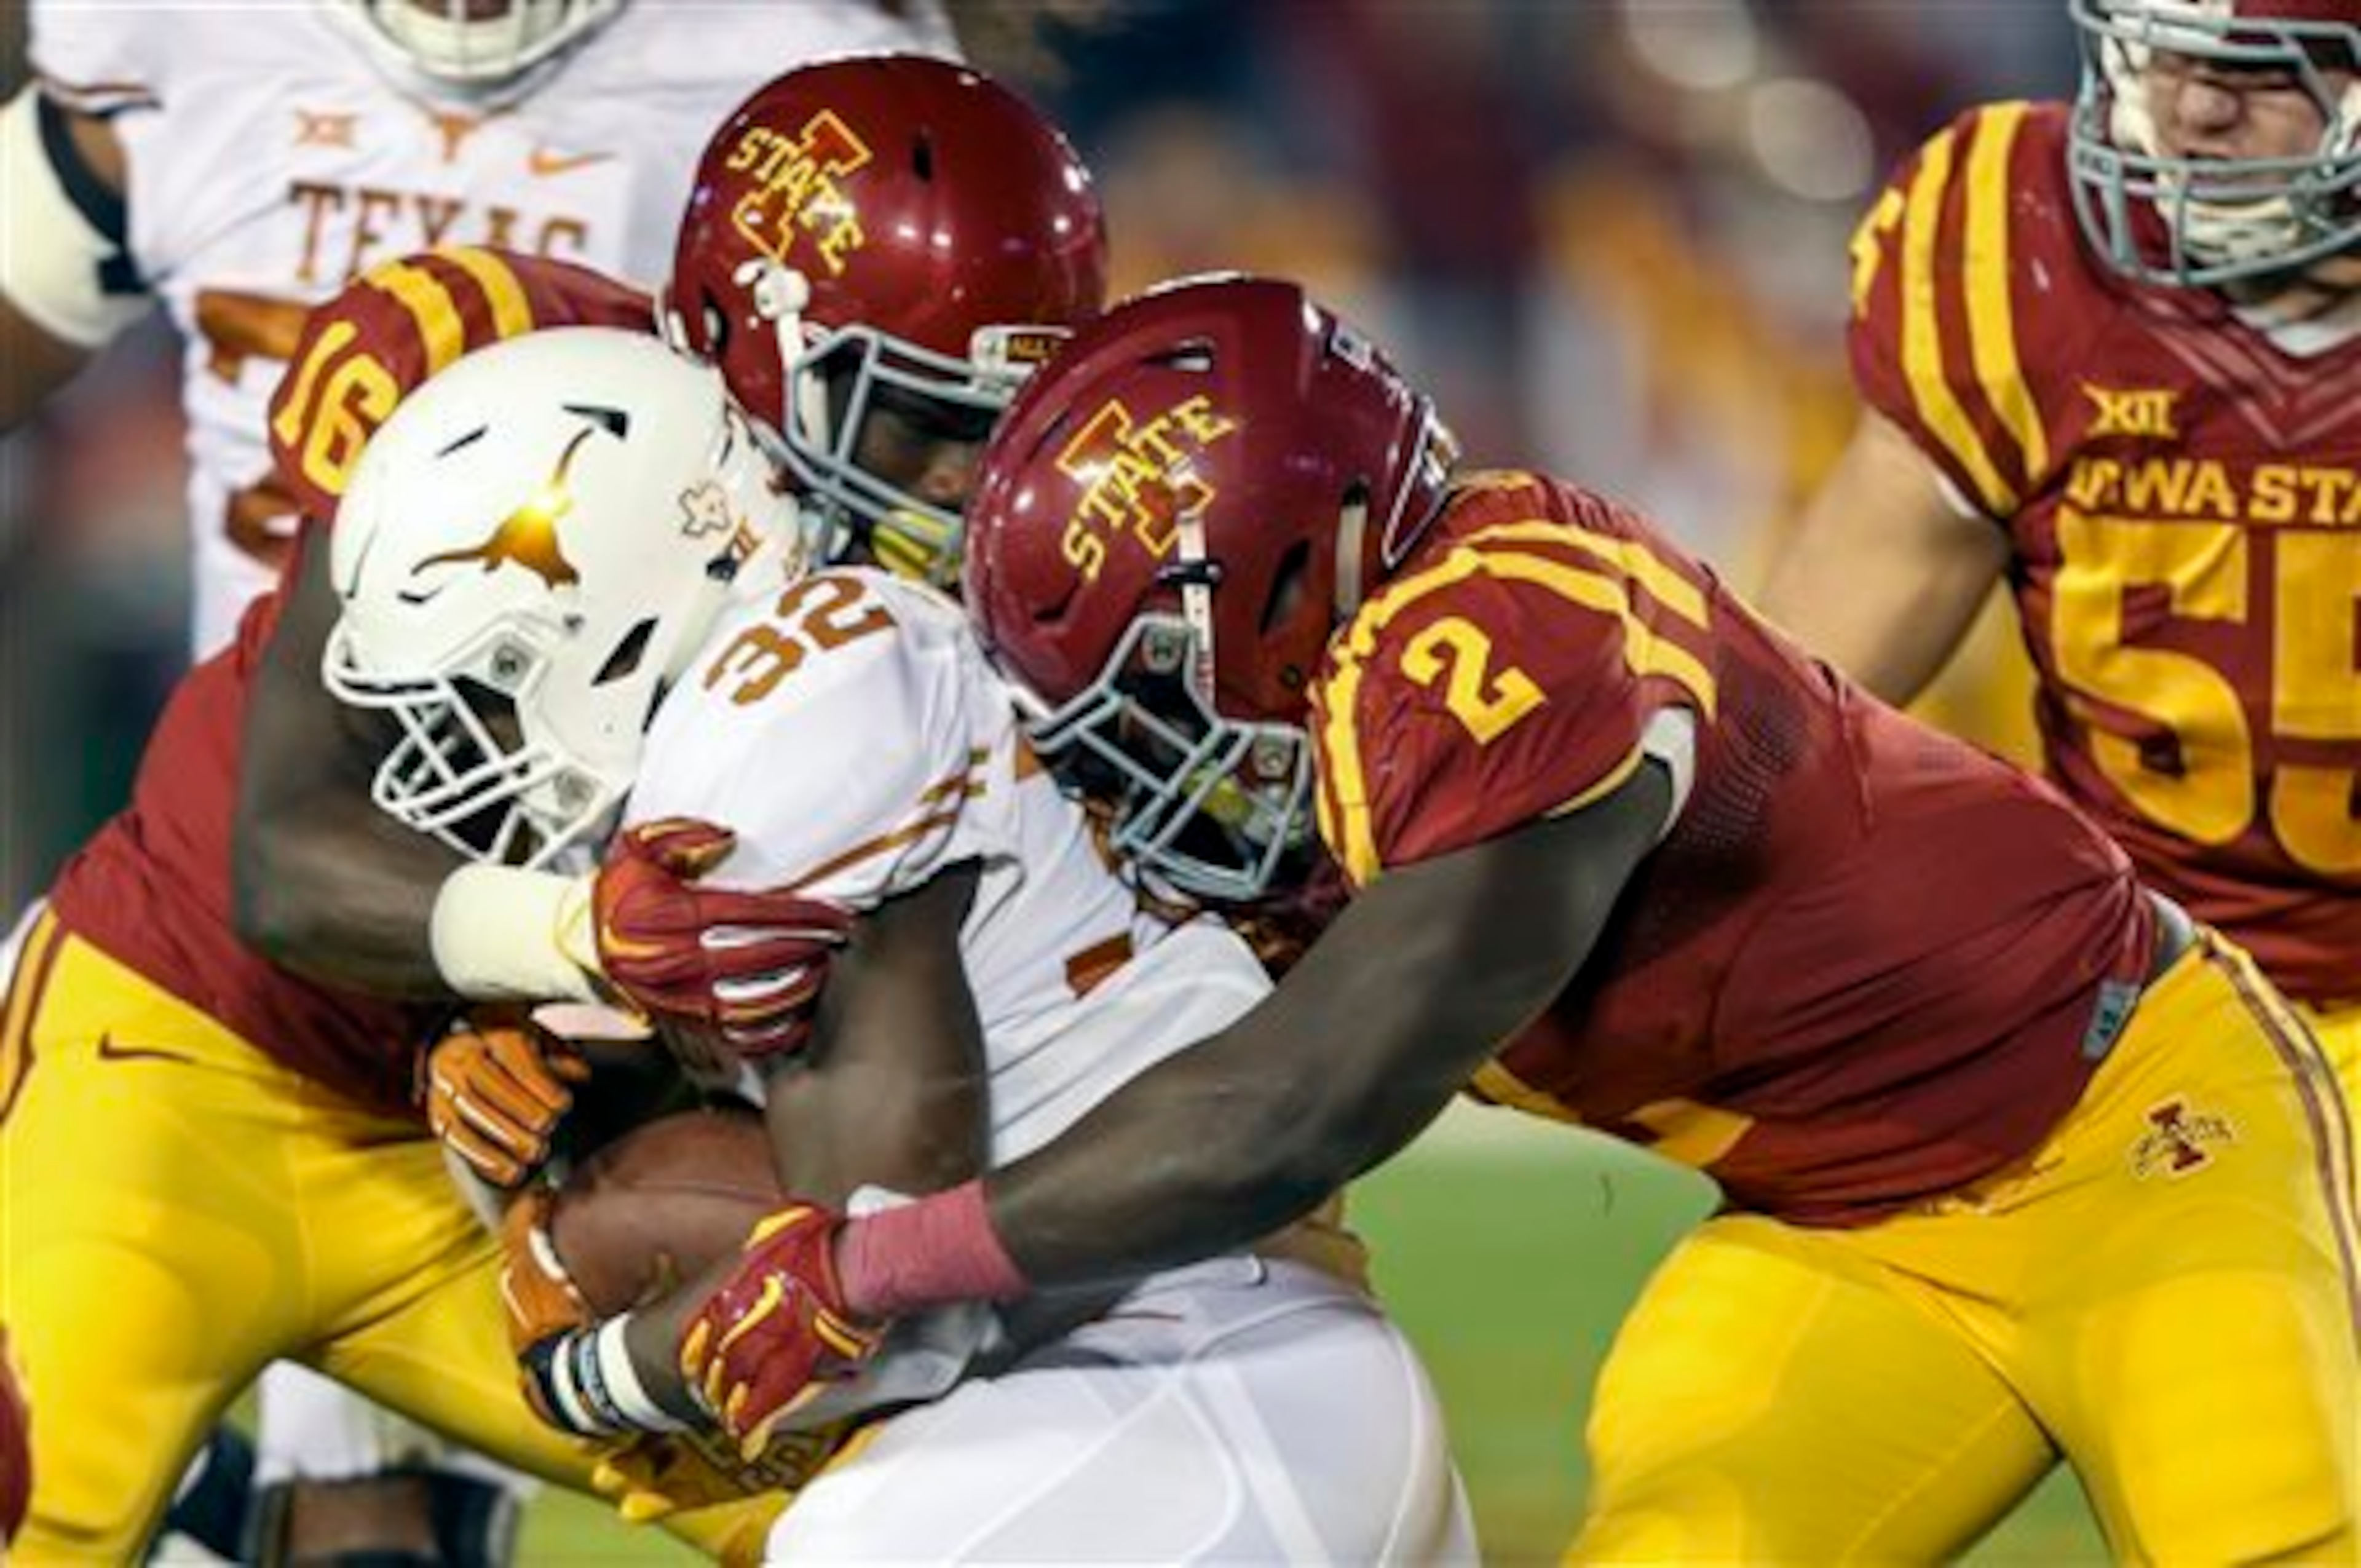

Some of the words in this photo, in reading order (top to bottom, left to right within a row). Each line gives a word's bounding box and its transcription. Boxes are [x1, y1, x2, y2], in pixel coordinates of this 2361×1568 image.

[726, 126, 864, 274] STATE
[272, 320, 401, 496] 16
[2082, 382, 2180, 440] XII
[1062, 395, 1235, 582] STATE
[700, 575, 900, 707] 32
[1399, 616, 1548, 746] 2
